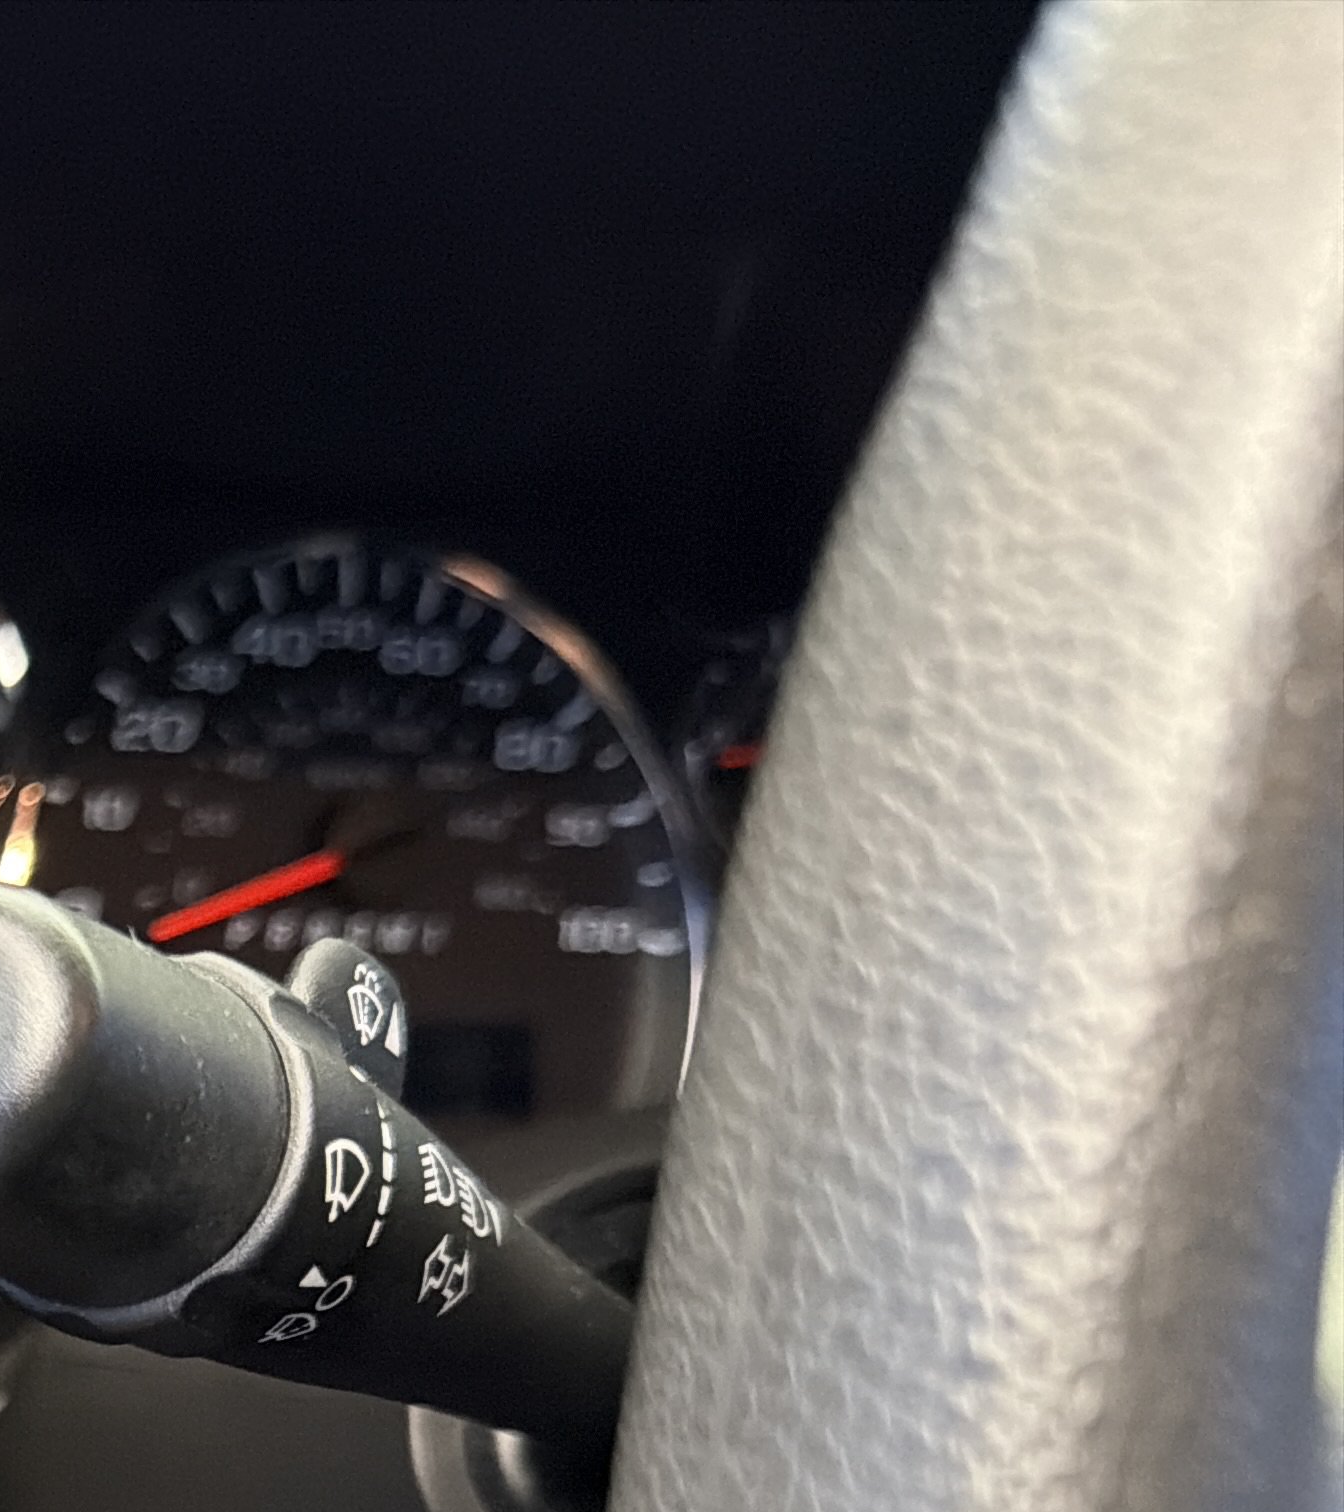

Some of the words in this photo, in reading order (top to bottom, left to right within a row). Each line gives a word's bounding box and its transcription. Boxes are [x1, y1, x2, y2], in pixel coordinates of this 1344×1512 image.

[233, 614, 318, 669] 40
[378, 629, 465, 677] 60
[111, 699, 206, 754] 20
[494, 717, 579, 774] 80
[558, 907, 642, 954] 100
